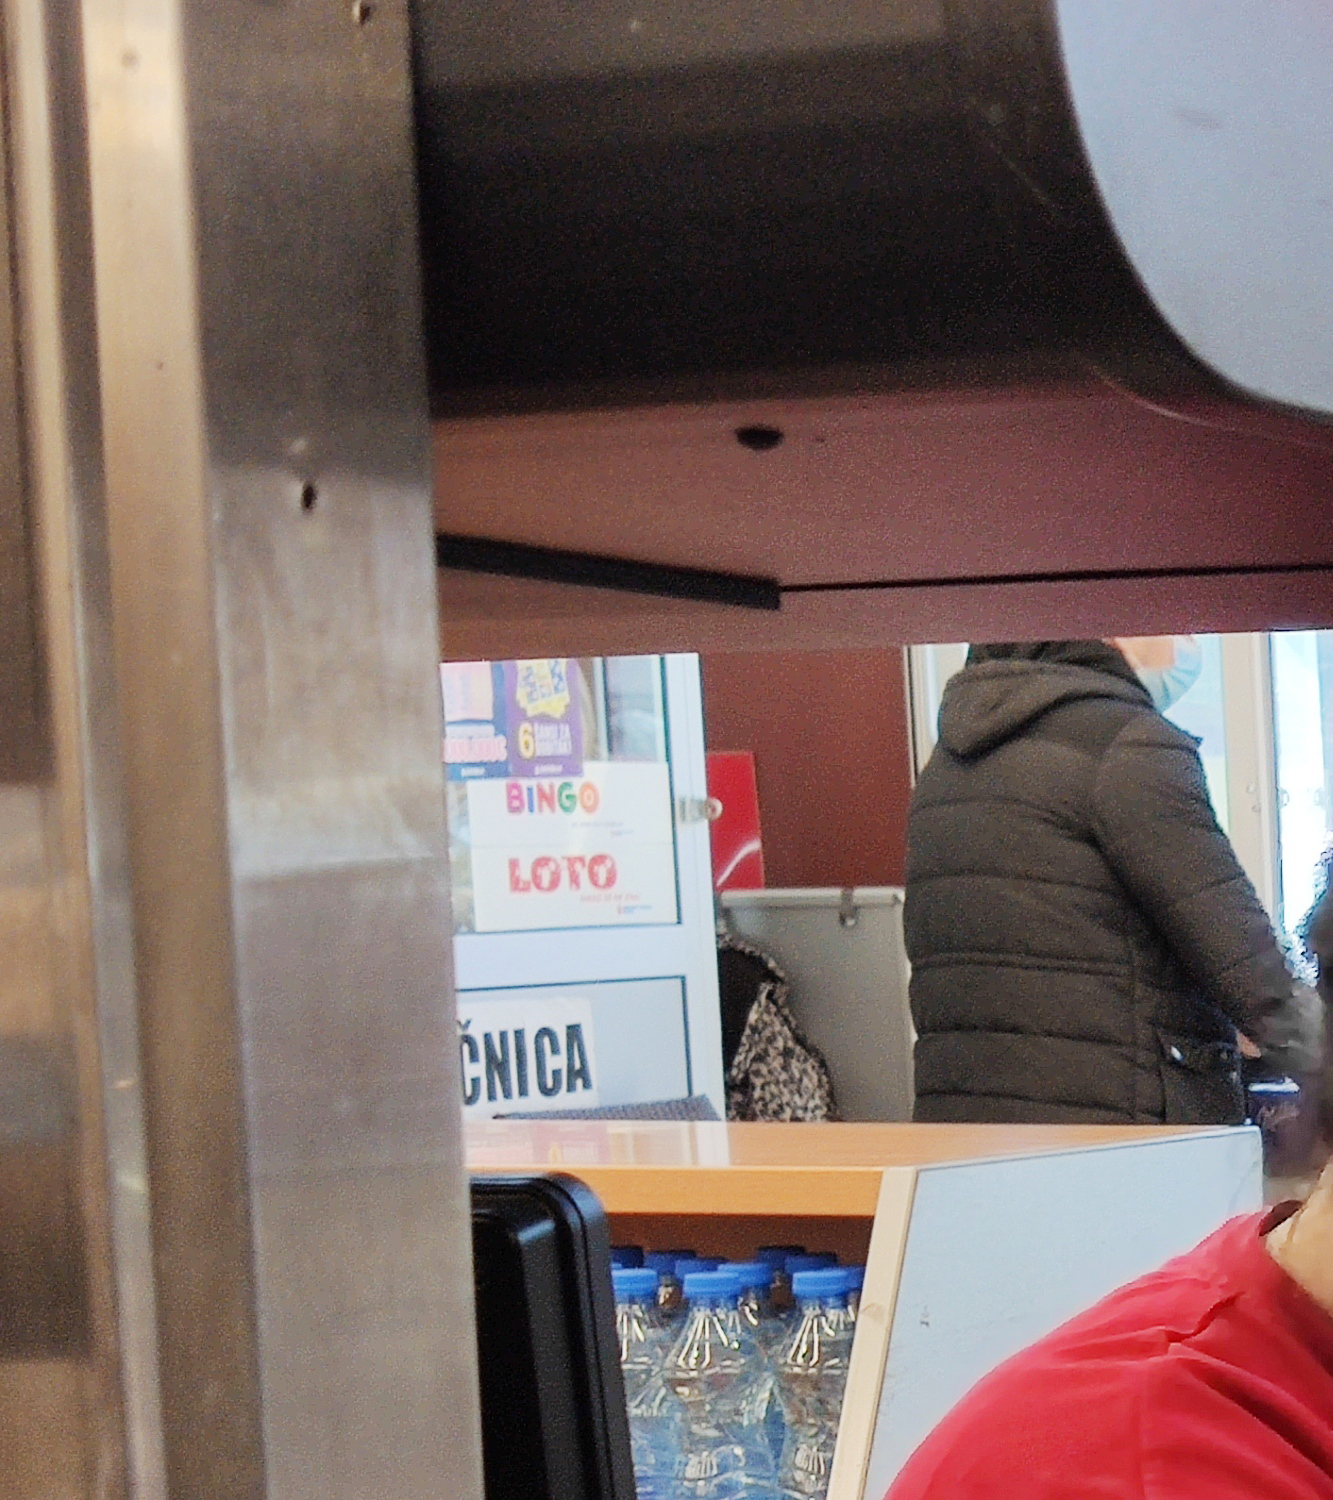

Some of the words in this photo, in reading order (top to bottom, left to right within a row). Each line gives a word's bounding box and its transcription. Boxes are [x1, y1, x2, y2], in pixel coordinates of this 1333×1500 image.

[518, 721, 537, 760] 6
[505, 781, 600, 815] BINGO
[507, 854, 618, 893] LOTO
